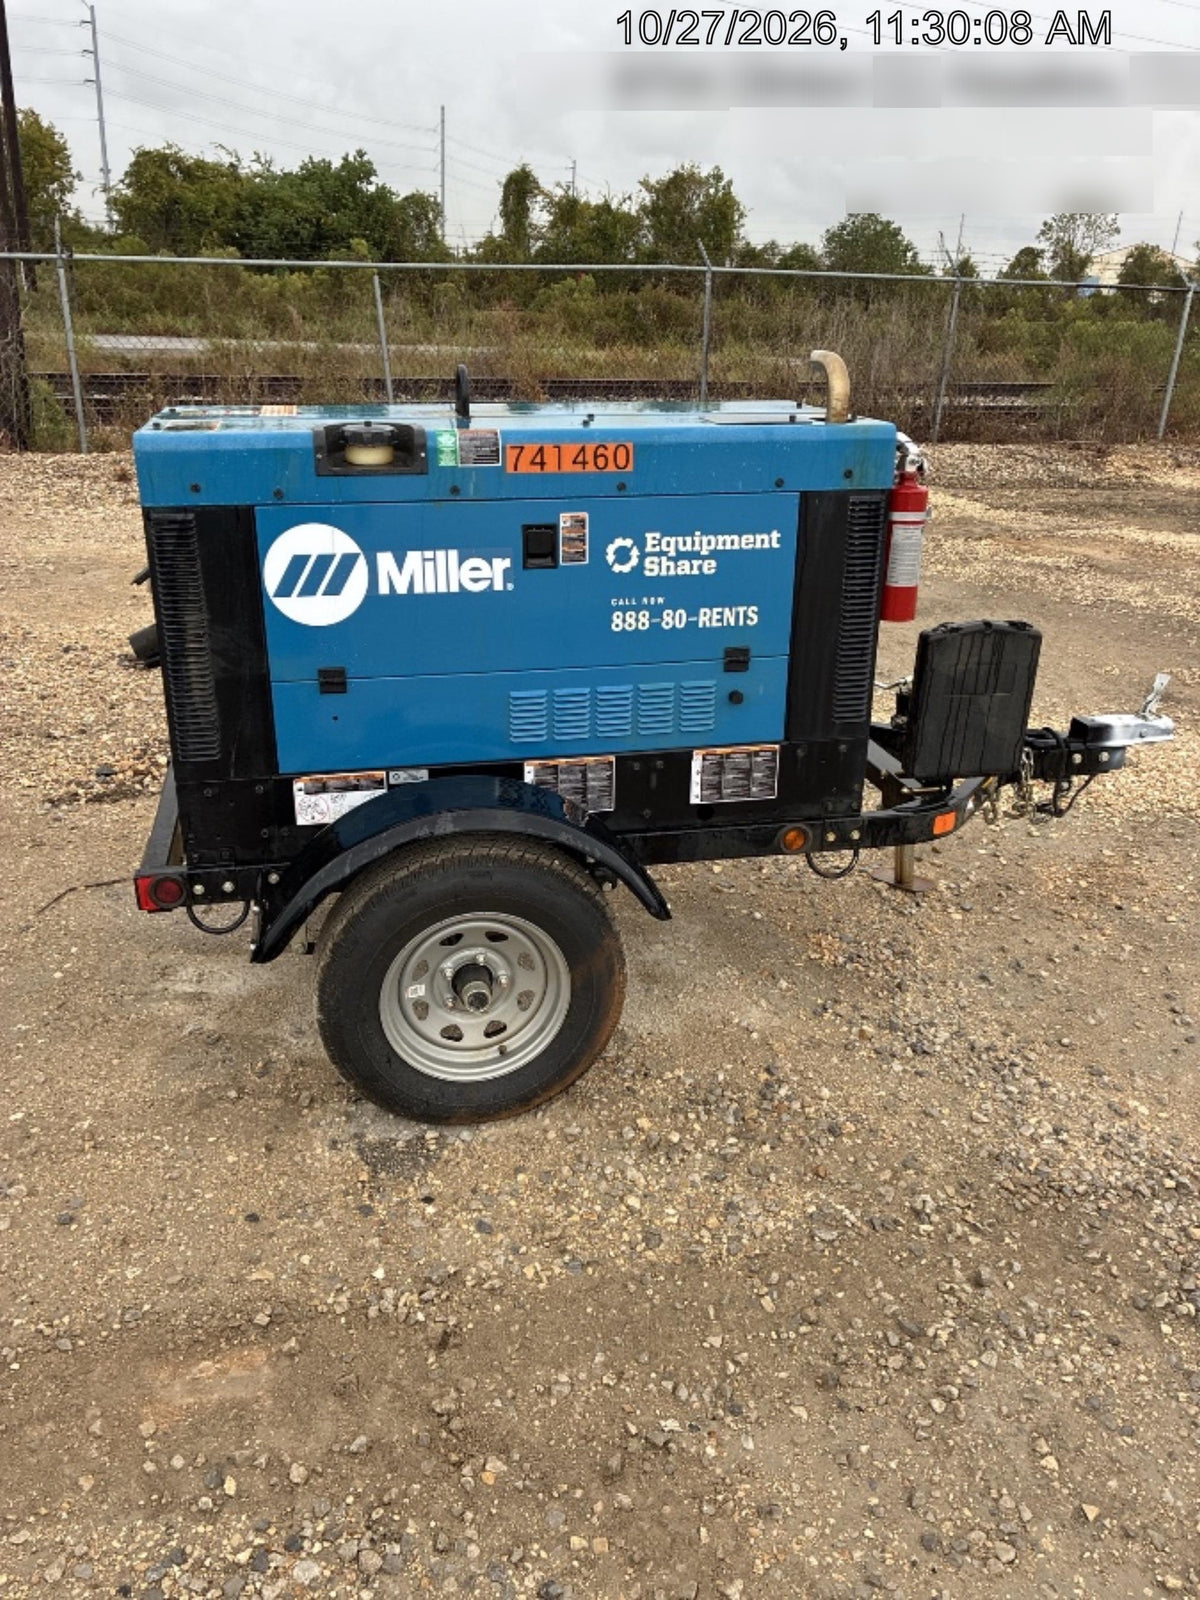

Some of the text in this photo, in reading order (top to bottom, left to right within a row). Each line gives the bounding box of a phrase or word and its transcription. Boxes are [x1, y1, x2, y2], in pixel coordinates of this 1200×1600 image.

[509, 443, 631, 472] 741460
[644, 529, 782, 557] Equipment
[376, 549, 511, 595] Miller
[643, 555, 718, 577] Share
[610, 596, 667, 607] CALL NOW
[610, 605, 759, 632] 888-80-RENTS
